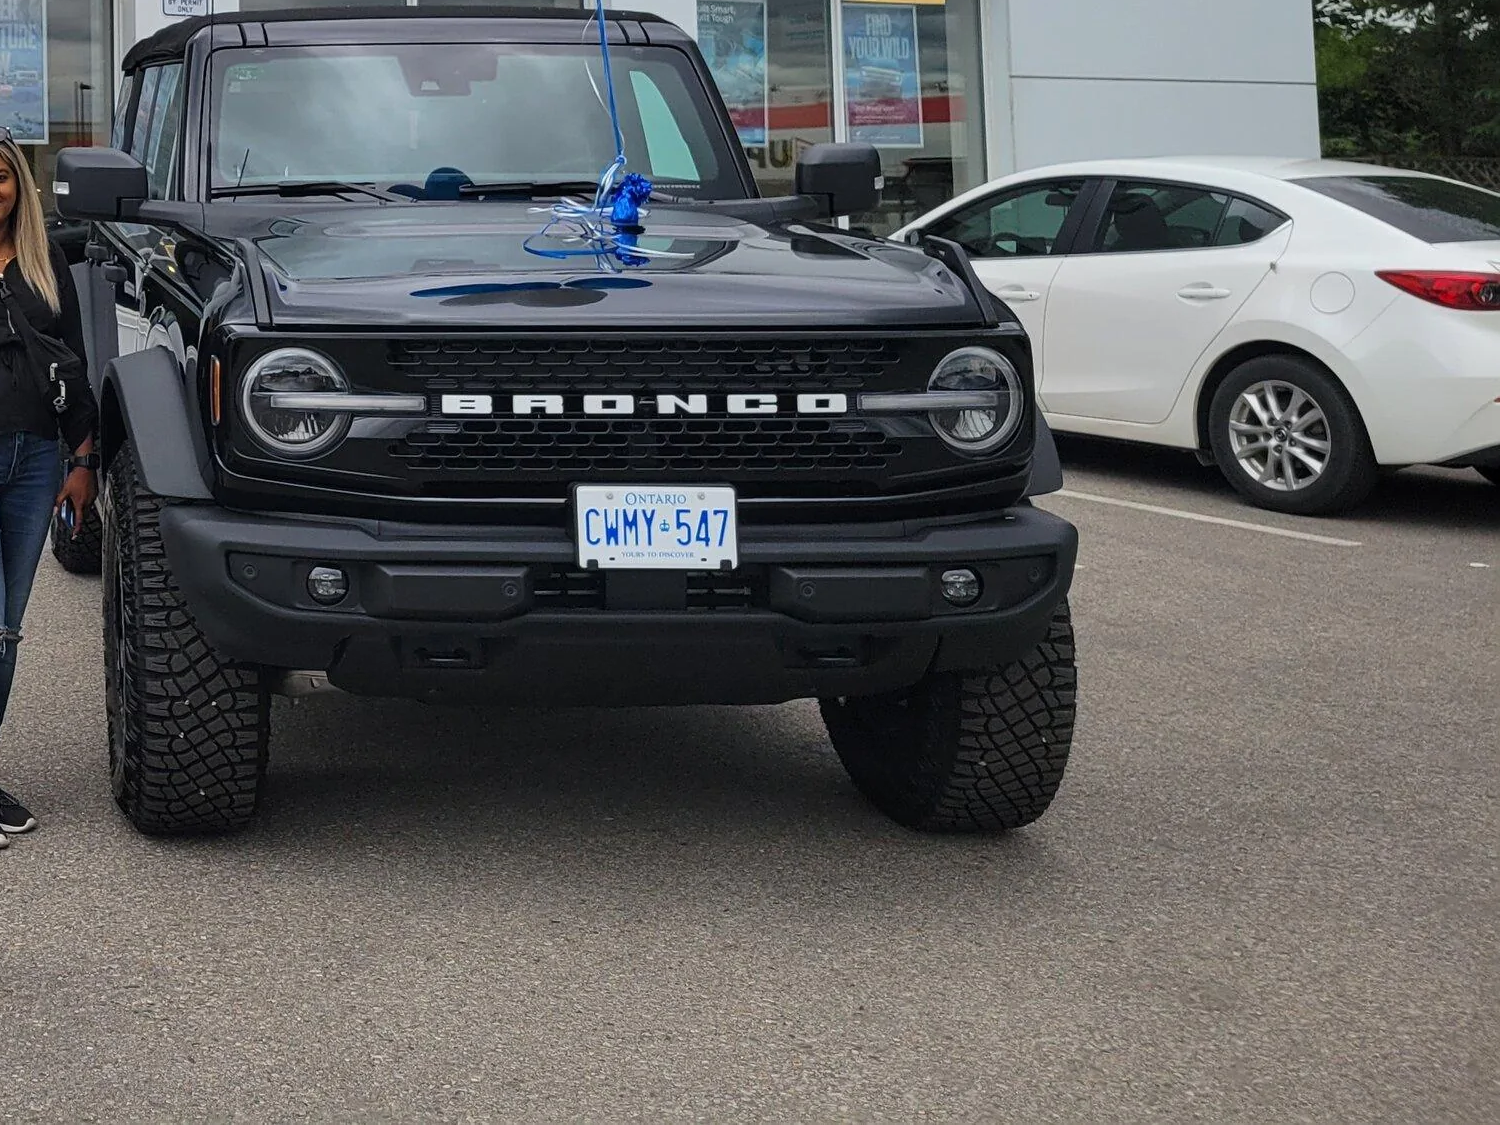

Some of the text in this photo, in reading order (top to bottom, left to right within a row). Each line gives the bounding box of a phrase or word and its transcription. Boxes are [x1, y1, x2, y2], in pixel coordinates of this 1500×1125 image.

[177, 5, 194, 13] ONLY
[180, 0, 203, 7] PERMIT
[865, 13, 892, 37] FIND
[848, 36, 880, 59] YOUR
[441, 393, 848, 415] BRONCO
[585, 508, 729, 547] CWMY 547
[658, 551, 695, 559] DISCOVER
